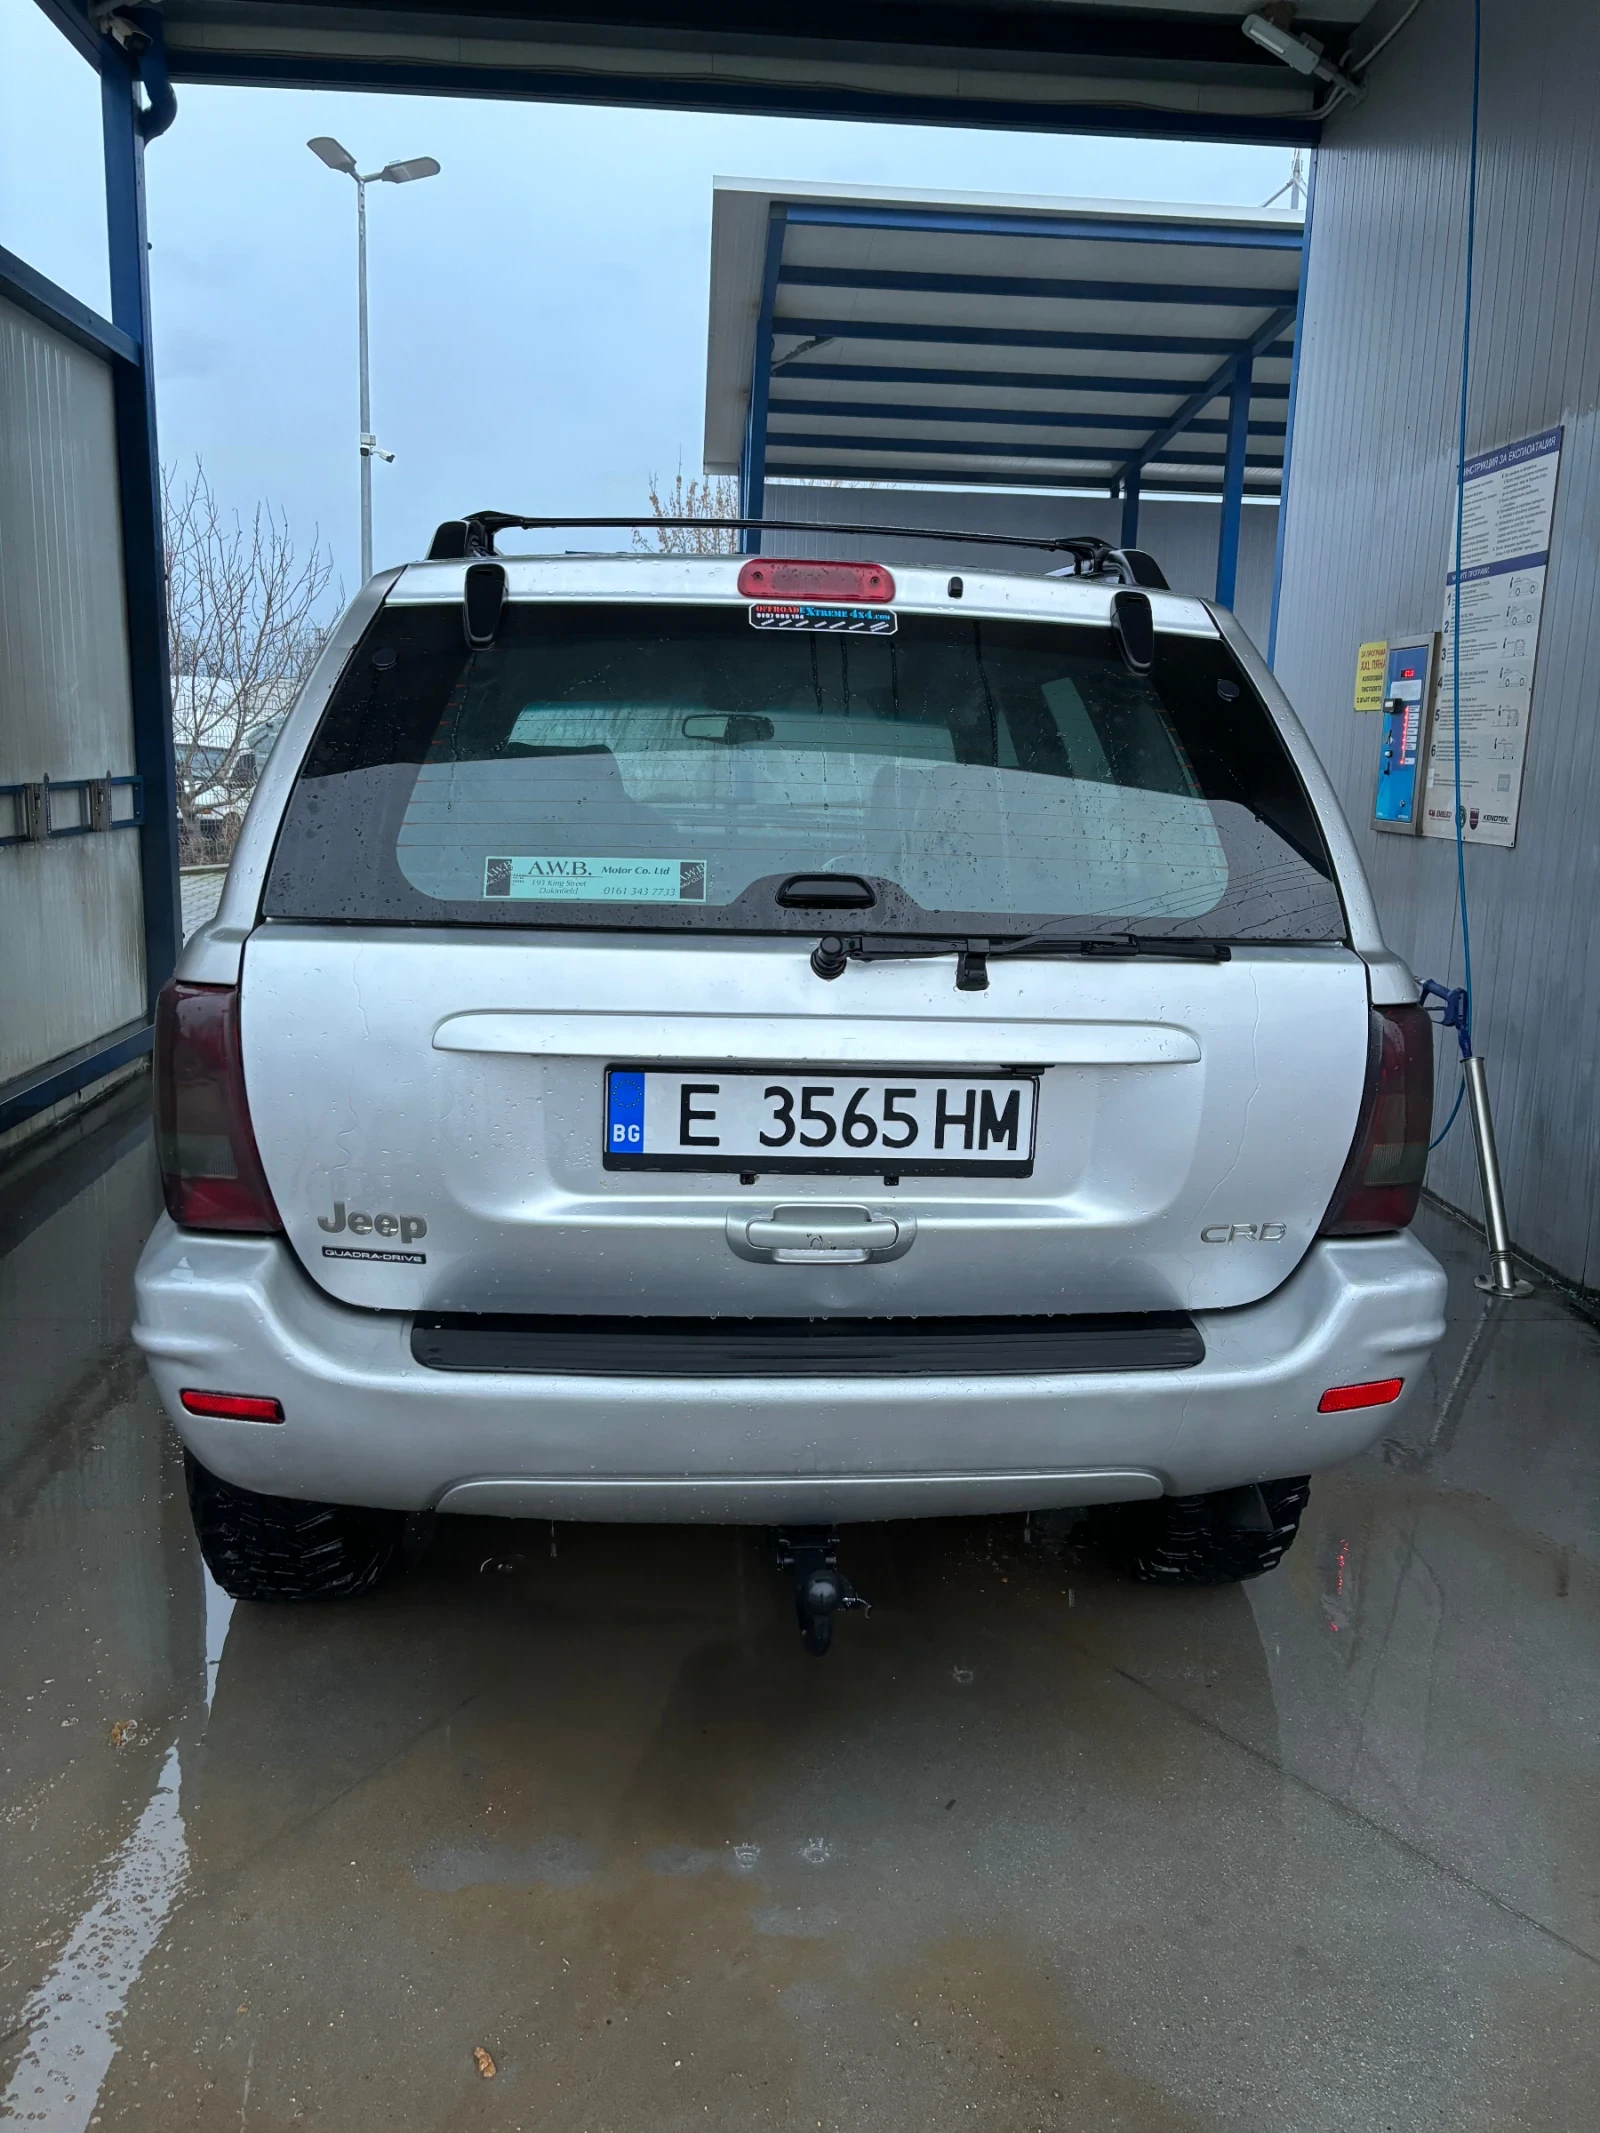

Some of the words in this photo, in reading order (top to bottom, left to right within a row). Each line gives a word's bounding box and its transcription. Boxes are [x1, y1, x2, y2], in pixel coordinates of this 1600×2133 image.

[1499, 453, 1507, 465] ЗА
[1508, 435, 1556, 460] ЕКСПЛОАТАЦИЯ
[1447, 593, 1451, 606] 1
[1444, 620, 1449, 633] 2
[1441, 648, 1446, 660] 3
[1437, 676, 1443, 689] 4
[1434, 709, 1440, 721] 5
[1431, 745, 1436, 757] 6
[1483, 814, 1509, 823] KENOTEK
[528, 860, 592, 876] A.W.B.
[602, 866, 632, 874] Motor
[635, 866, 651, 875] Co.
[654, 866, 671, 875] Ltd
[547, 879, 564, 888] King
[539, 887, 578, 895] Dukinfield
[603, 887, 628, 895] 0161
[631, 887, 649, 896] 343
[651, 887, 676, 897] 7733
[680, 1083, 720, 1147] E
[758, 1085, 919, 1149] 3565
[934, 1087, 1021, 1151] HM
[613, 1123, 640, 1143] BG
[317, 1200, 428, 1244] Jeep
[1200, 1222, 1287, 1243] CRD
[324, 1249, 423, 1263] QUADRA-DRIVE
